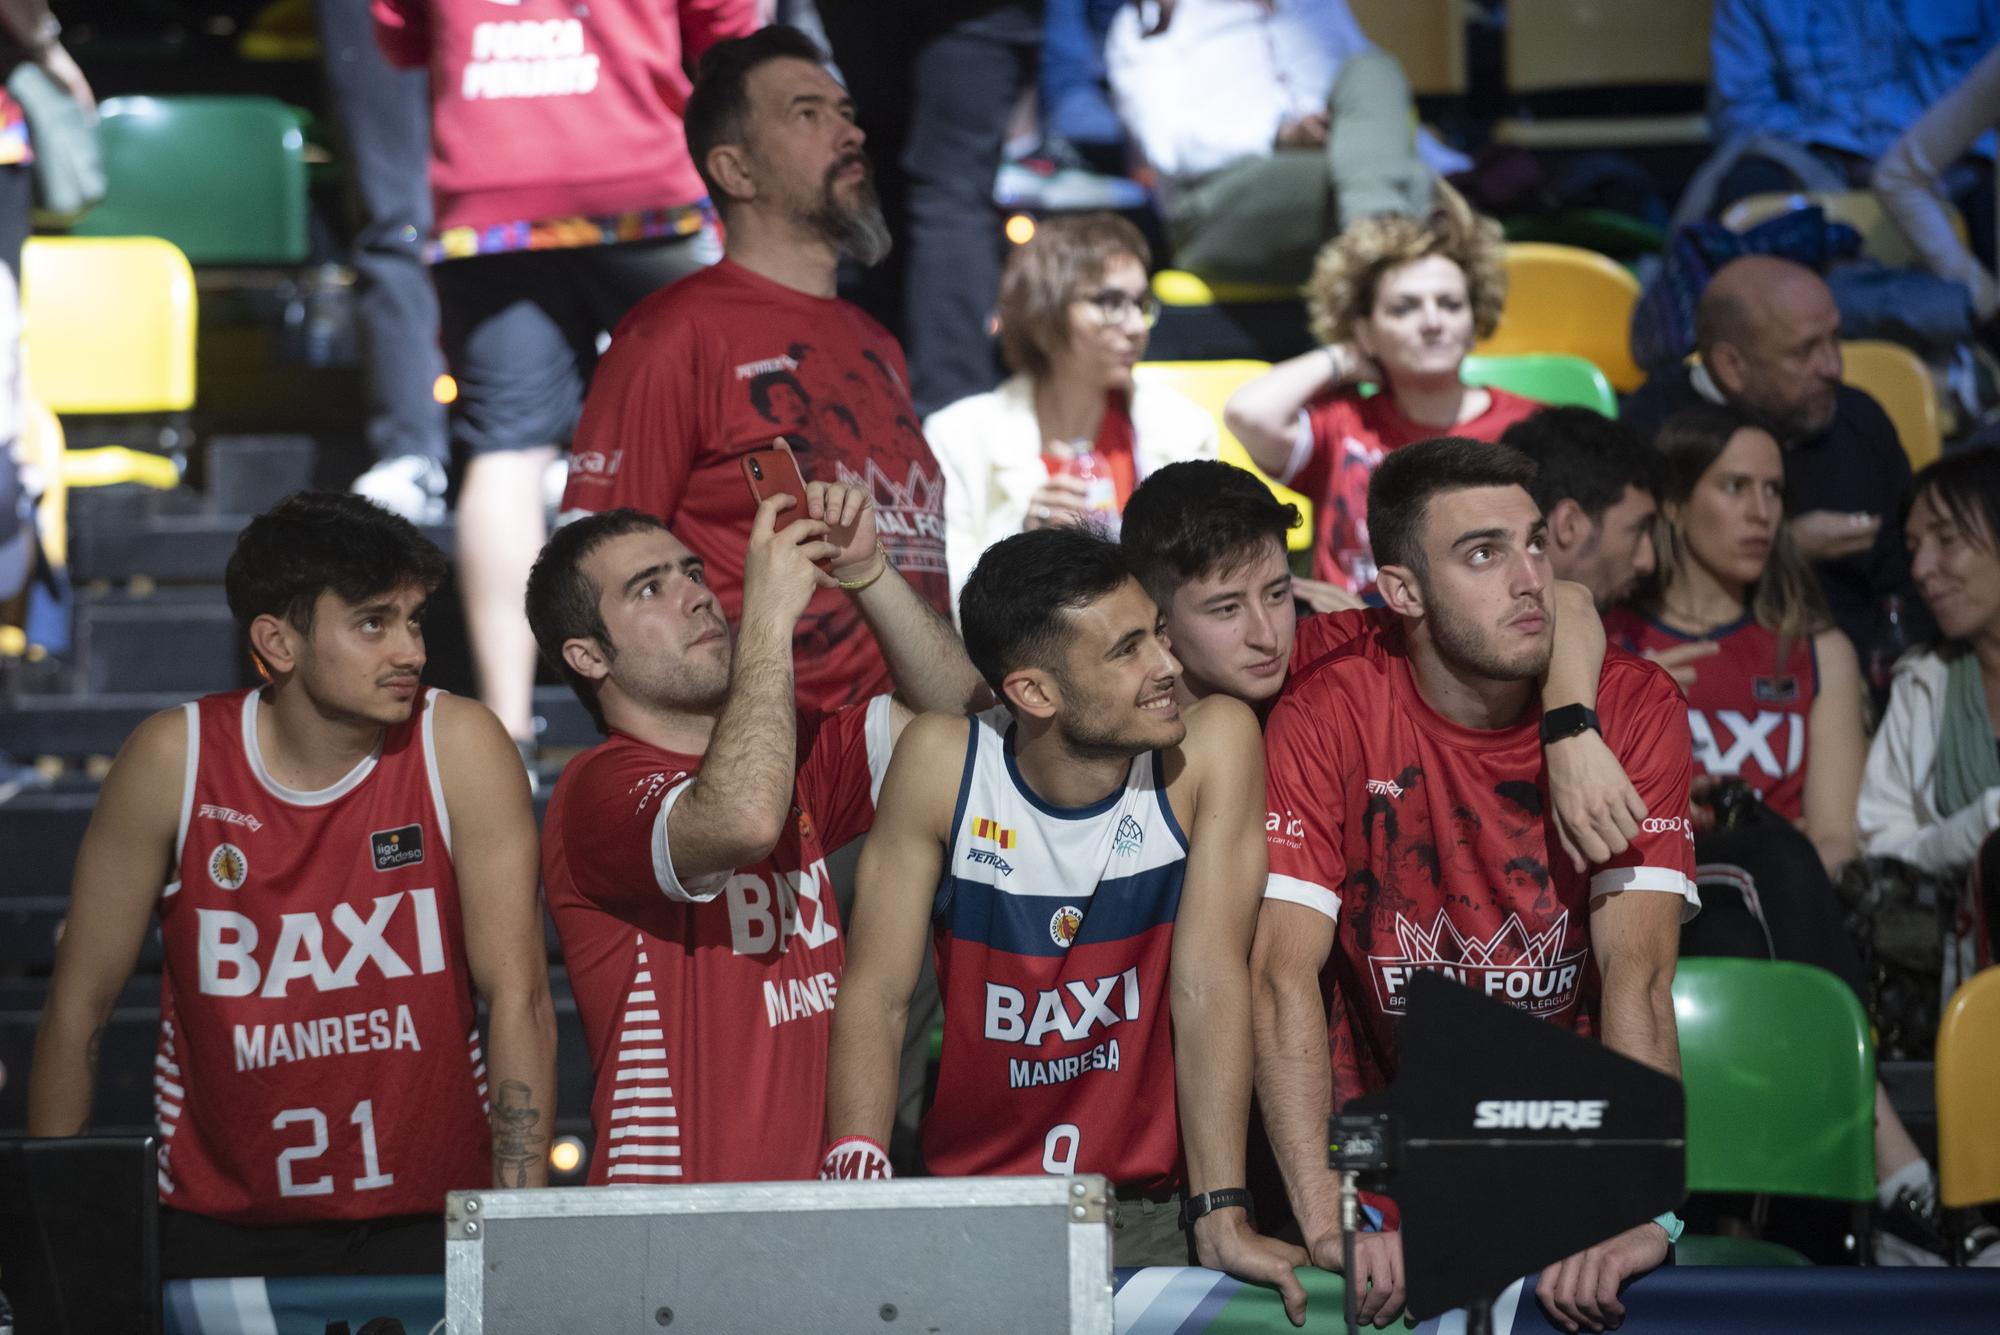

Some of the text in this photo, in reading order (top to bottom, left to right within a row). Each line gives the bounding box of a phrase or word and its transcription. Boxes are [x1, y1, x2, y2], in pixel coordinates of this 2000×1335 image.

[1687, 709, 1805, 781] AXI
[377, 842, 399, 856] liga
[379, 848, 422, 865] endesa
[726, 857, 838, 956] BAX
[196, 887, 446, 999] BAXI
[983, 966, 1140, 1046] BAXI
[1484, 964, 1578, 1000] FOUR
[1529, 991, 1572, 1011] LEAGUE
[233, 1004, 421, 1073] MANRESA
[1009, 1038, 1120, 1089] MANRESA
[1473, 1099, 1607, 1131] SHURE
[271, 1099, 394, 1197] 21
